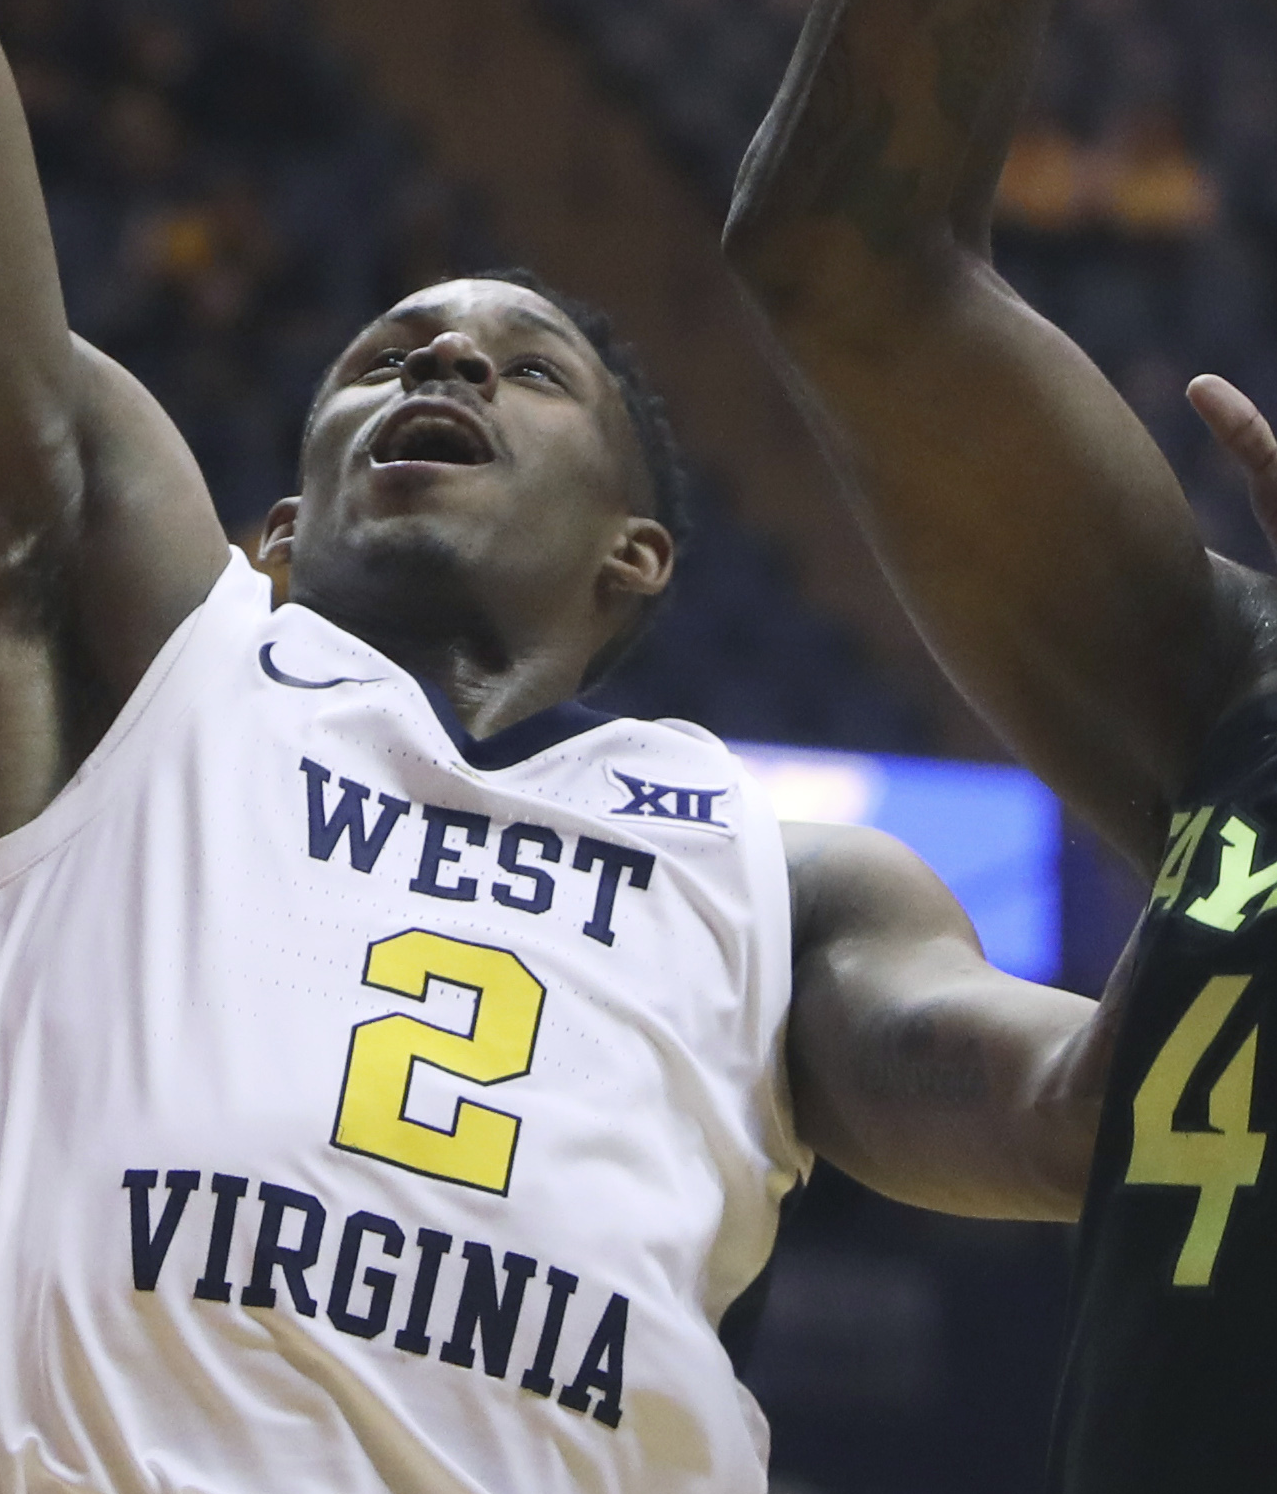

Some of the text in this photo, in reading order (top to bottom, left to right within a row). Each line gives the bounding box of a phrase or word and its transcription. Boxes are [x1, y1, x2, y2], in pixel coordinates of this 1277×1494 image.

[299, 756, 656, 947] WEST
[329, 928, 547, 1197] 2
[1125, 974, 1268, 1286] 4
[122, 1169, 630, 1429] VIRGINIA
